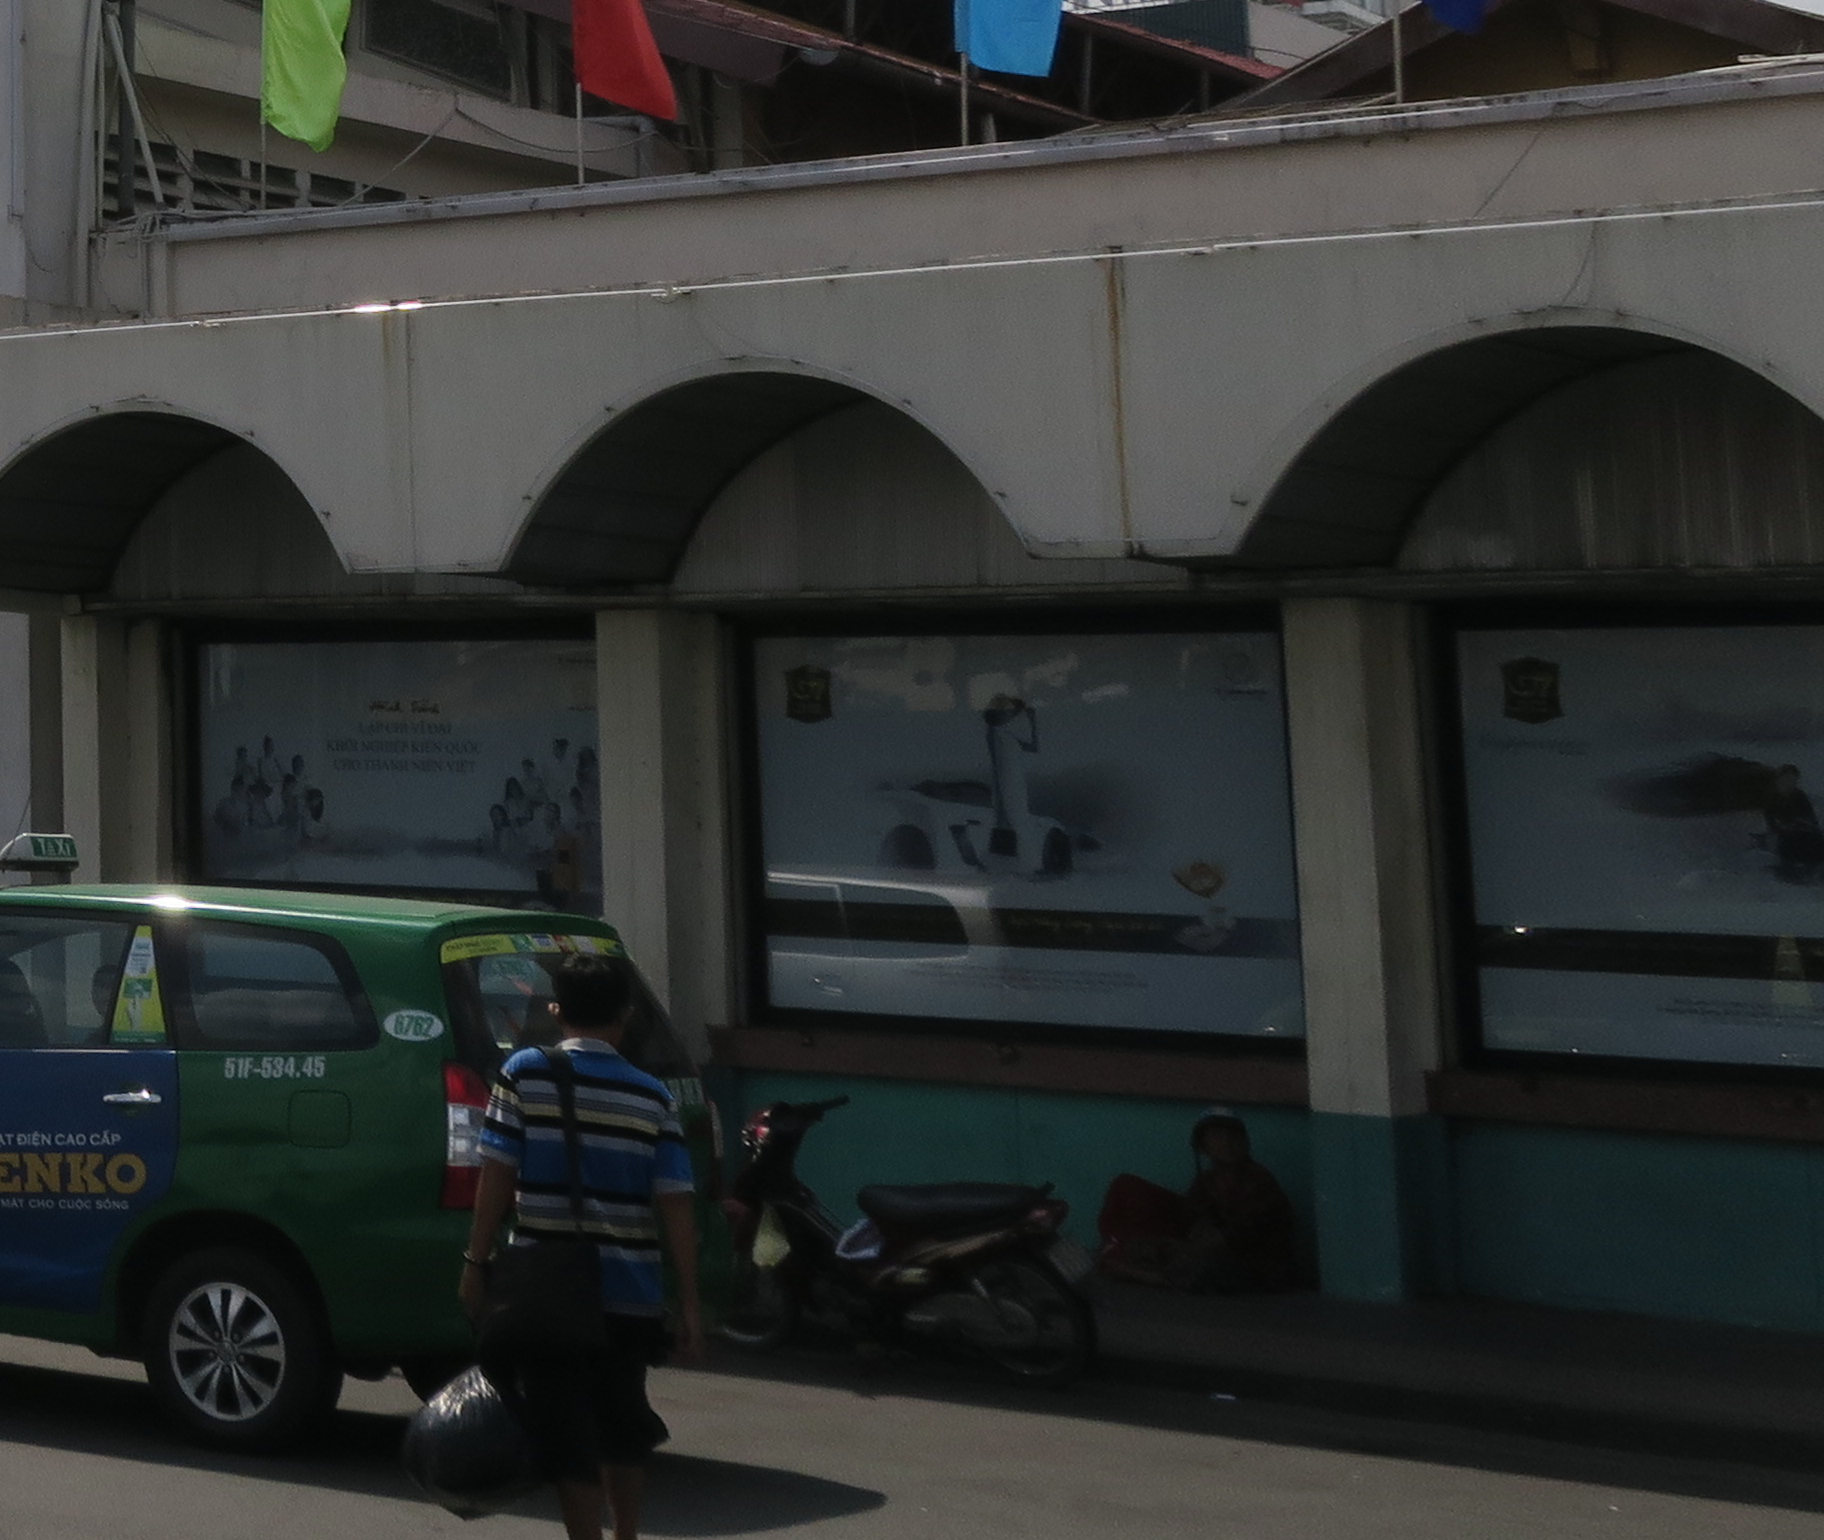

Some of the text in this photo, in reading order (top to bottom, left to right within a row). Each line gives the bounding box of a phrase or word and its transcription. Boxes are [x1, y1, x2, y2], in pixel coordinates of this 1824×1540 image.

[36, 838, 71, 856] TAXI
[224, 1056, 326, 1079] 51F-534.45
[16, 1131, 52, 1148] ĐIỆN
[54, 1133, 87, 1146] CAO
[89, 1129, 121, 1146] CẤP
[28, 1199, 55, 1209] CHO
[58, 1198, 92, 1210] CUỘC
[96, 1197, 130, 1210] SỐNG
